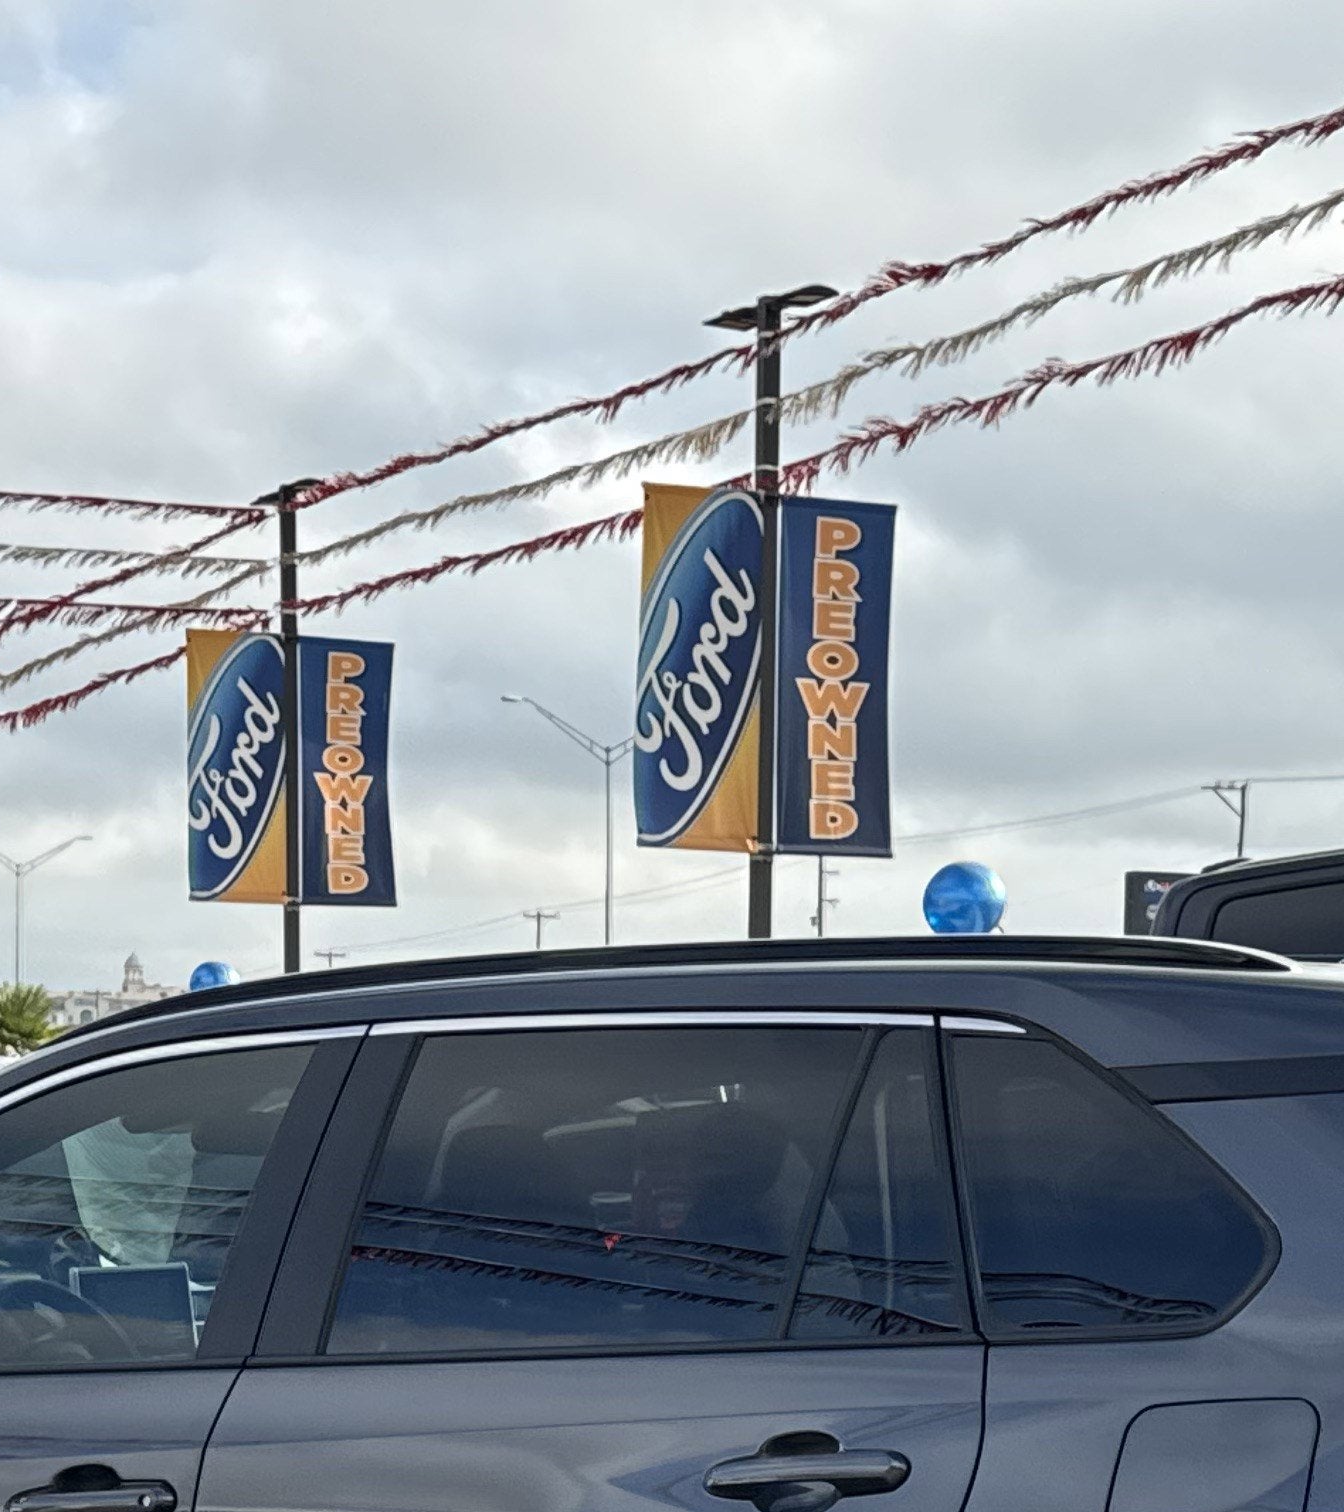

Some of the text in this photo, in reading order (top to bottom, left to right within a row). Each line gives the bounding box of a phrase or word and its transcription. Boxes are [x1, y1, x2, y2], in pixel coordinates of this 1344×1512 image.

[189, 676, 281, 861] Ford
[313, 651, 374, 895] PREOWNED
[634, 548, 757, 792] Ford
[794, 515, 871, 841] PREOWNED
